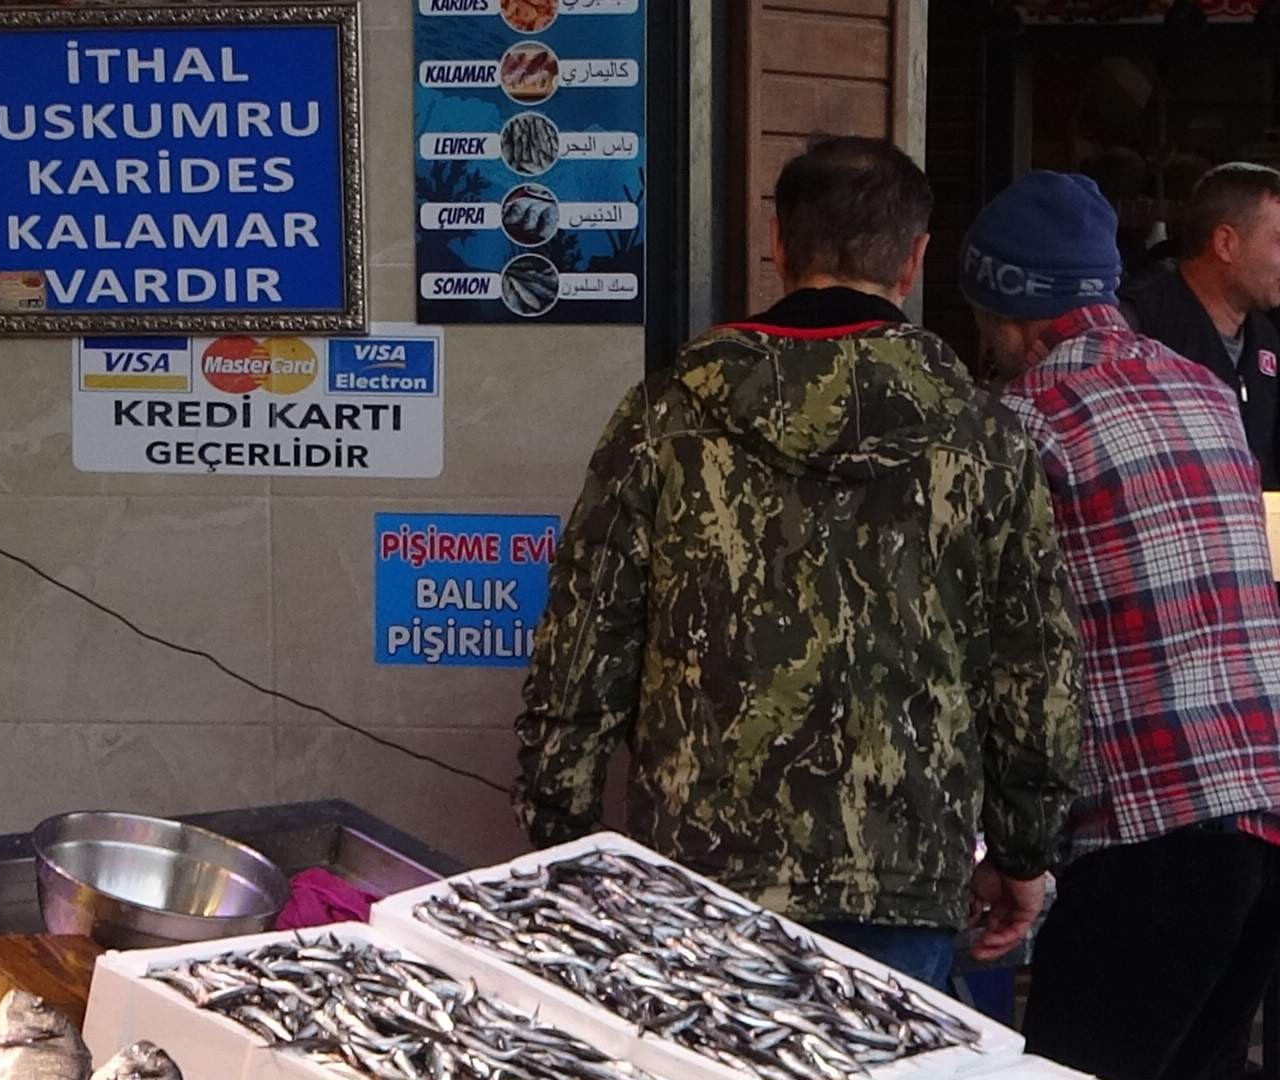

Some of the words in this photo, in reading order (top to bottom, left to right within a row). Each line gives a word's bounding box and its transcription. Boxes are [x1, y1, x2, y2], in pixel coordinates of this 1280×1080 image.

[66, 40, 249, 84] İTHAL
[425, 66, 496, 83] KALAMAR
[434, 138, 487, 155] LEVREK
[28, 150, 294, 196] KARİDES
[7, 212, 319, 251] KALAMAR
[438, 207, 485, 228] ÇUPRA
[46, 268, 281, 304] VARDIR
[433, 278, 490, 295] SOMON
[965, 246, 1055, 296] FACE
[104, 352, 171, 373] VISA
[204, 353, 317, 375] MasterCard
[354, 345, 406, 361] VISA
[335, 374, 427, 390] Electron
[114, 395, 251, 428] KREDİ
[269, 402, 401, 431] KARTI
[146, 437, 369, 473] GEÇERLİDİR
[382, 524, 501, 568] PİŞİRME
[511, 526, 557, 564] EVİ
[416, 577, 518, 610] BALIK
